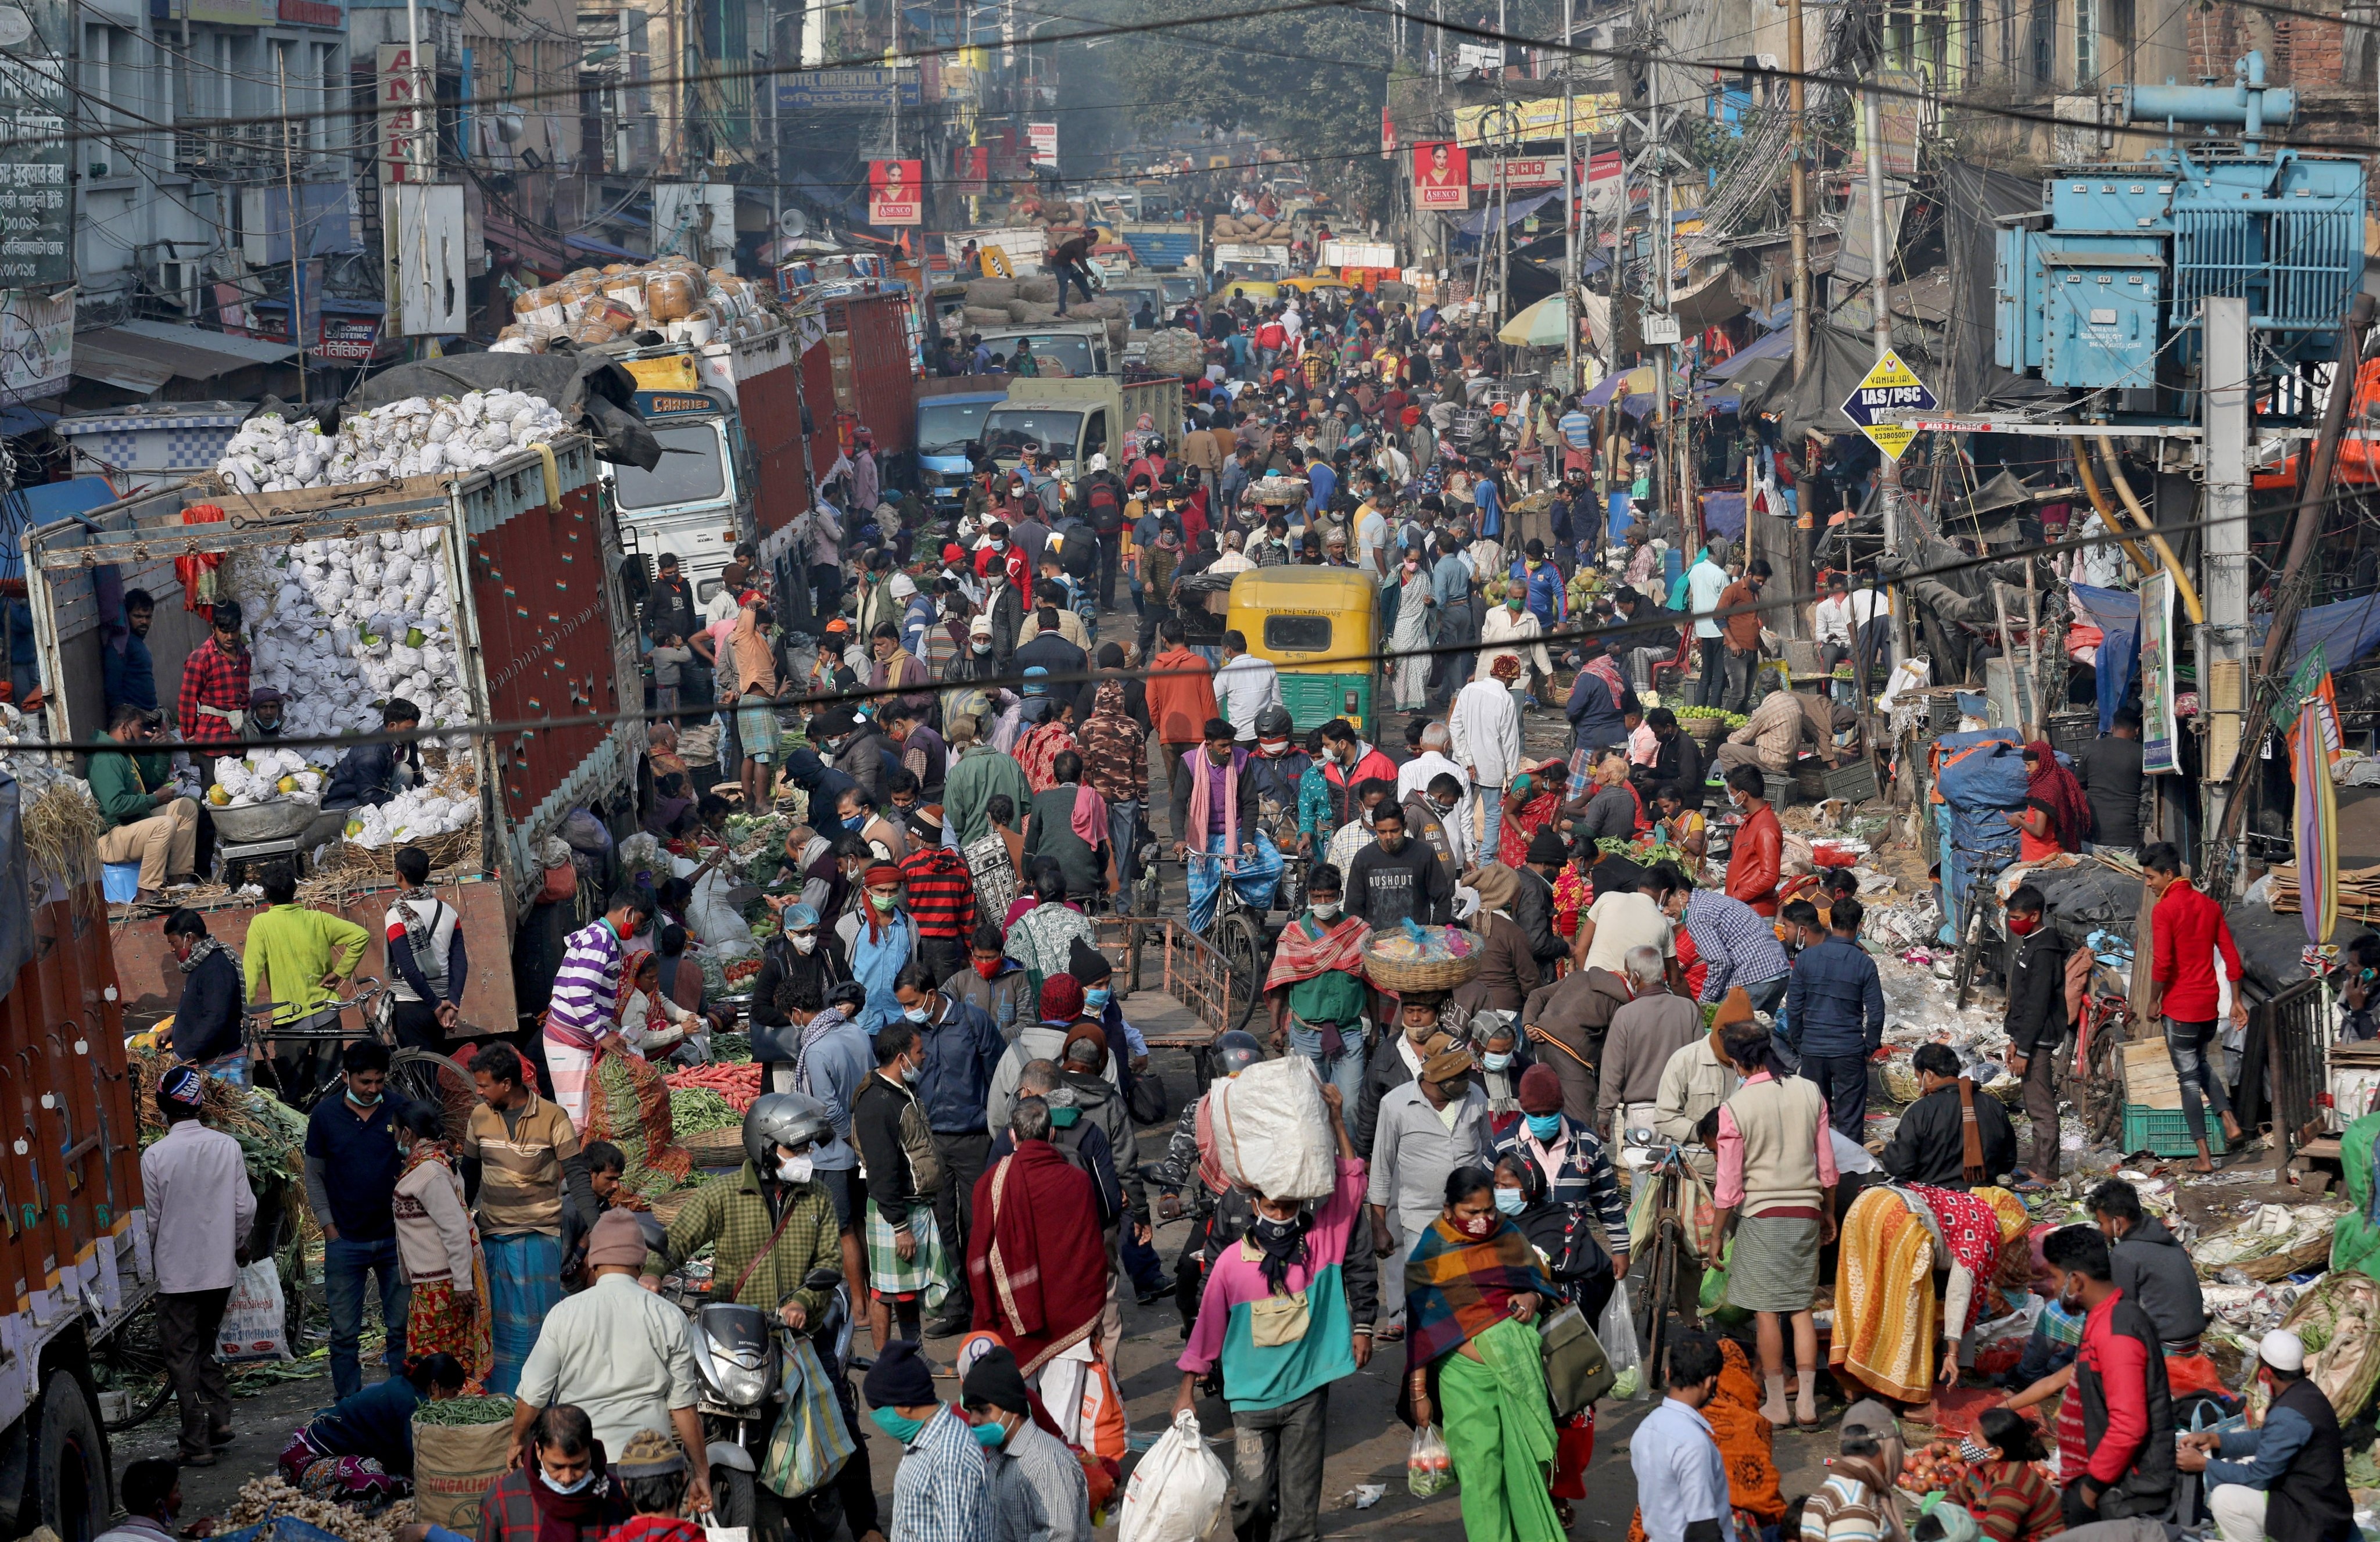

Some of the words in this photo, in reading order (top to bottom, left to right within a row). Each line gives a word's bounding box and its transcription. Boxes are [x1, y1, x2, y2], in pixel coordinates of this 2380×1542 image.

[779, 75, 816, 87] HOTEL
[819, 73, 878, 86] ORIENTAL
[13, 164, 46, 187] সুকুমার
[48, 164, 64, 184] রায়
[2, 236, 46, 256] বেলিয়াঘাটা
[47, 242, 64, 256] রোড
[2143, 284, 2149, 295] R
[1870, 375, 1911, 385] VANIK-IAS
[37, 383, 49, 396] STREET
[1861, 386, 1922, 407] IAS/PSC
[652, 396, 710, 414] CARRIER
[1874, 431, 1913, 440] 8338050077
[910, 826, 923, 837] NIKE
[1433, 842, 1442, 851] TO
[1438, 852, 1449, 862] ACE
[1369, 874, 1413, 887] RUSHOUT
[322, 1072, 342, 1092] NEELAM
[237, 1329, 253, 1342] Silk
[255, 1328, 279, 1339] House
[837, 1333, 845, 1358] ICORN
[1239, 1436, 1261, 1454] NEW
